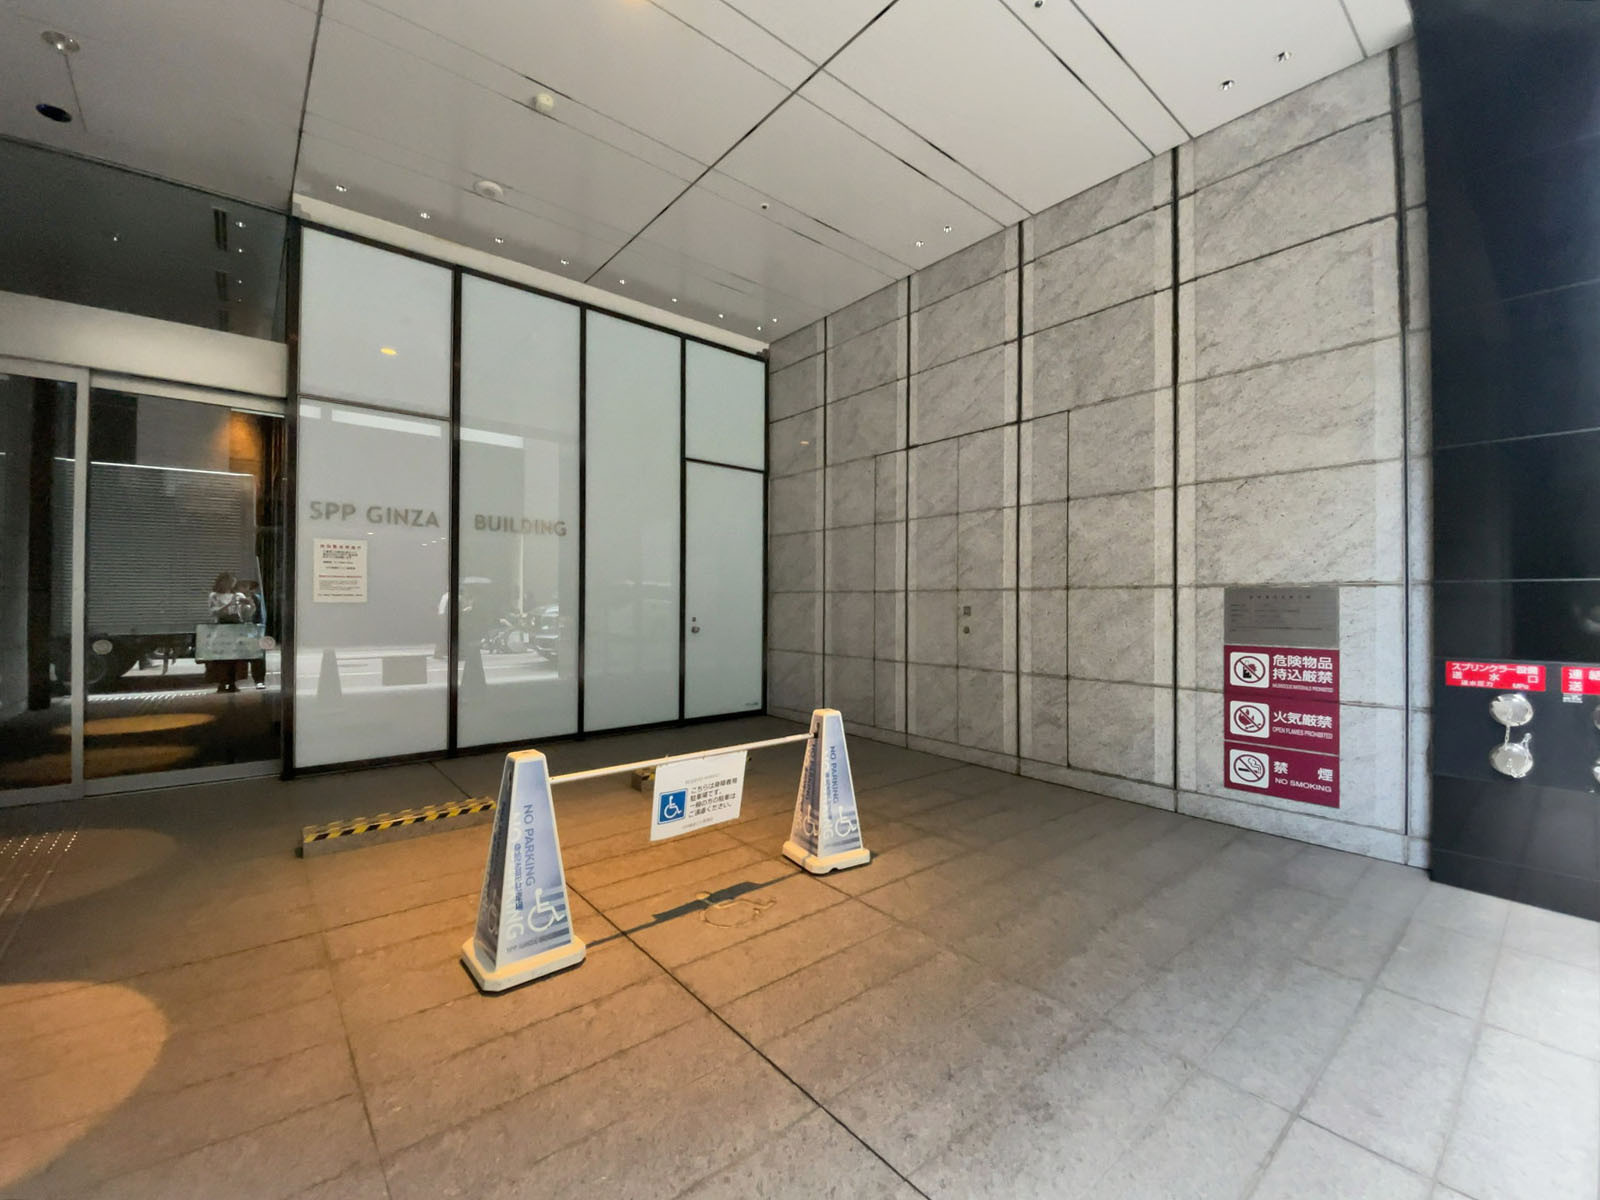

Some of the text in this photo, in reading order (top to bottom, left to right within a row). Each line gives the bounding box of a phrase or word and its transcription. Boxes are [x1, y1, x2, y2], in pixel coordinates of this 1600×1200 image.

[309, 501, 567, 537] SPP GINZA BUILDING
[1272, 654, 1333, 670] 危険物品
[1452, 662, 1539, 675] スプリンクラー設備
[1272, 668, 1333, 684] 持込厳禁
[1273, 711, 1333, 729] 火気厳禁
[1286, 728, 1303, 736] FLAMES
[1304, 730, 1333, 740] PROHIBITED
[830, 745, 837, 760] NO
[831, 763, 839, 804] PARKING
[1275, 777, 1332, 793] NO SMOKING
[523, 803, 536, 887] NO PARKING
